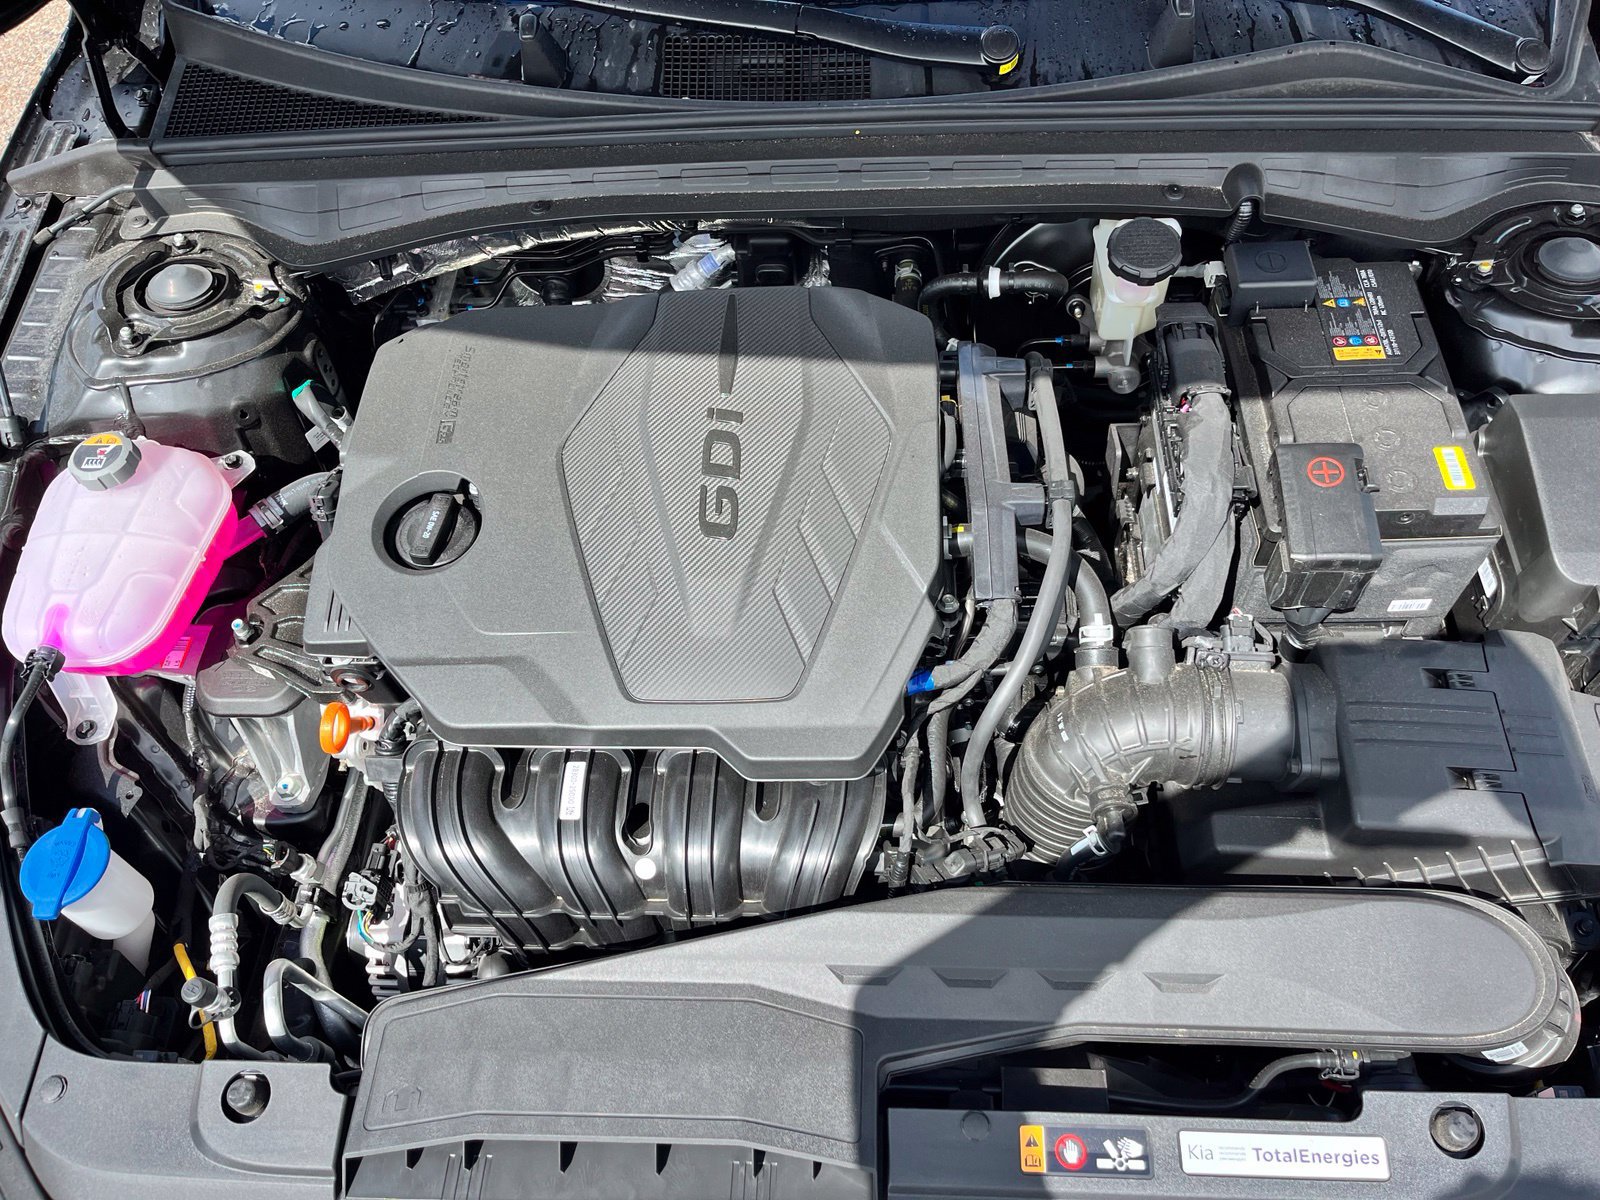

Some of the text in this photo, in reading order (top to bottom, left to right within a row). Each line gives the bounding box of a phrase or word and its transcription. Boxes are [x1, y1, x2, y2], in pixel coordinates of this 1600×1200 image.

[698, 407, 744, 541] GDi
[1187, 1144, 1381, 1168] Kia TotalEnergies
